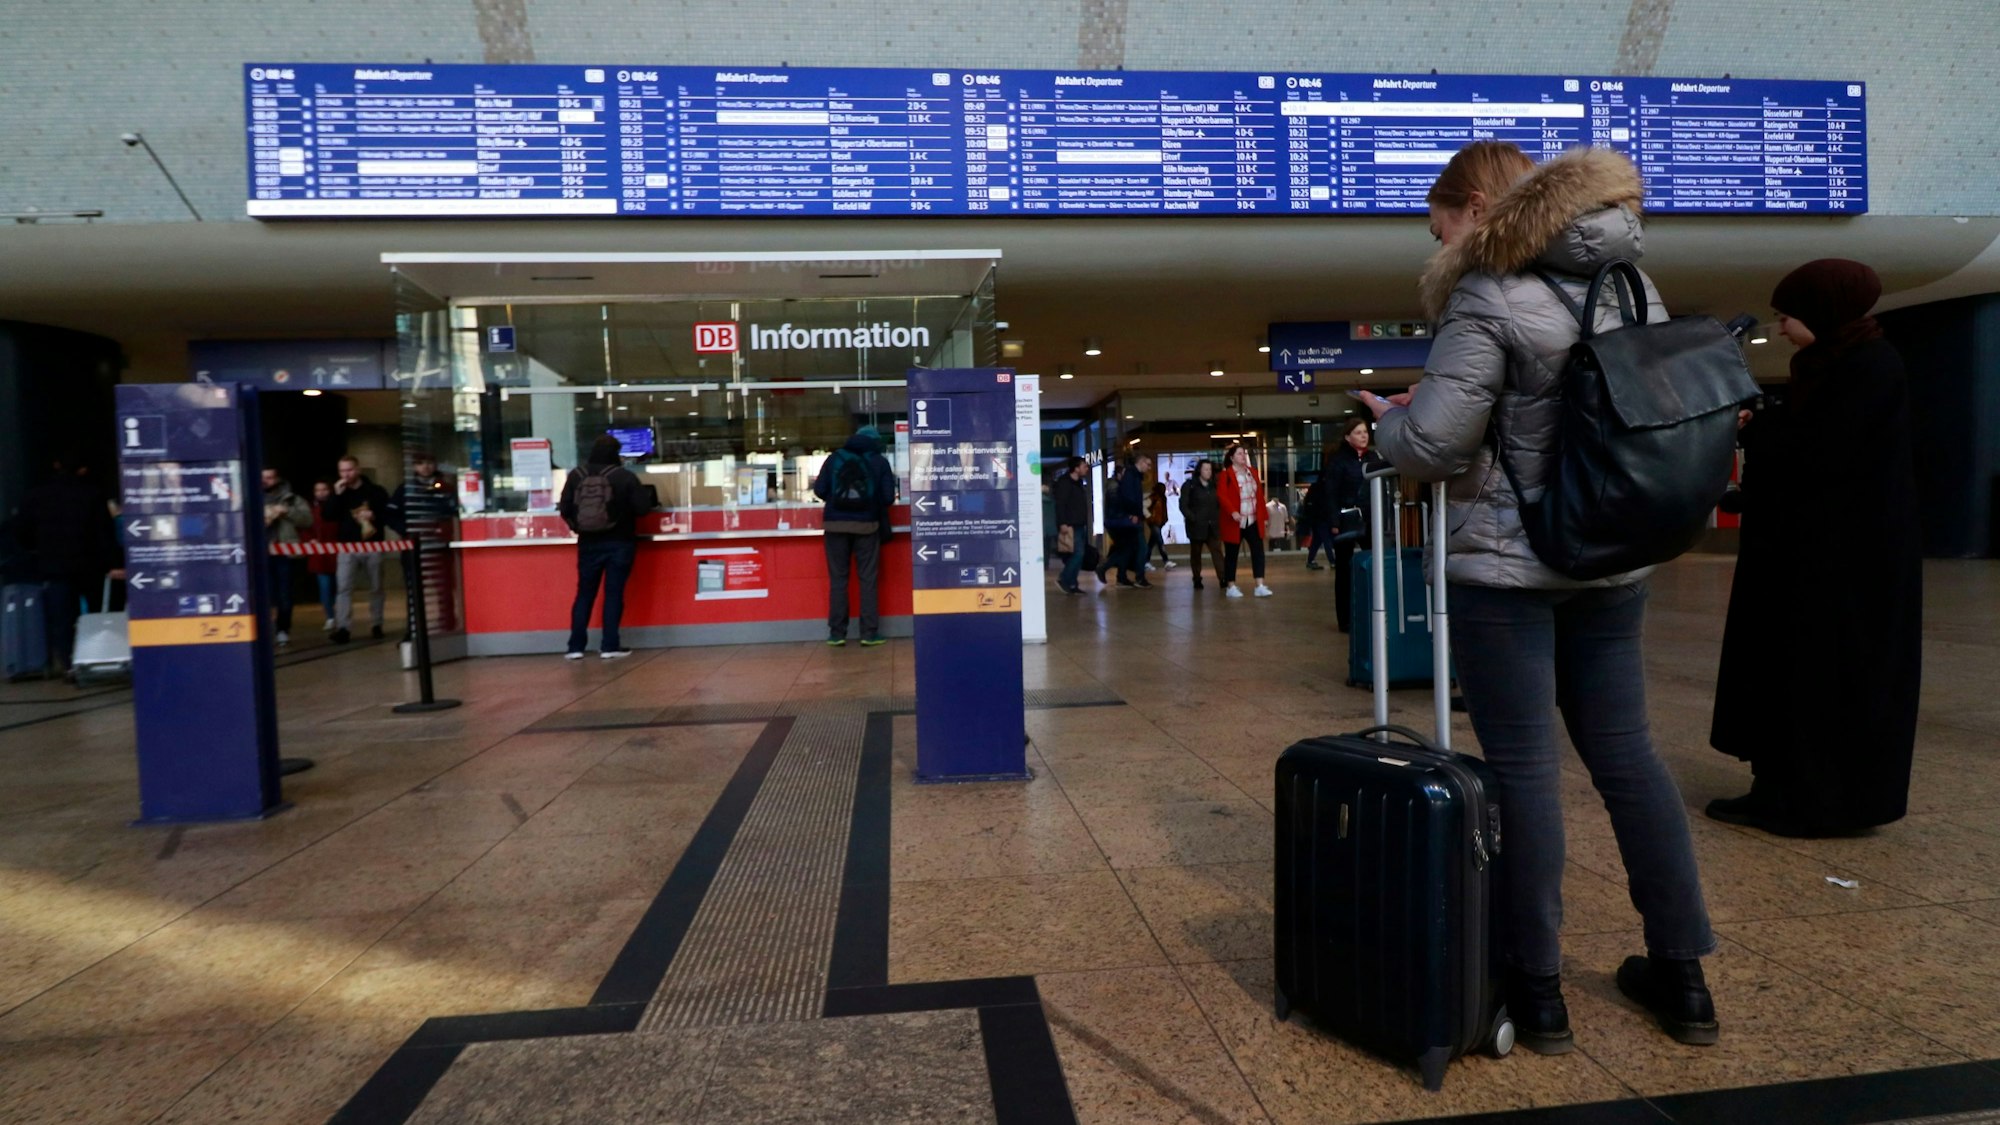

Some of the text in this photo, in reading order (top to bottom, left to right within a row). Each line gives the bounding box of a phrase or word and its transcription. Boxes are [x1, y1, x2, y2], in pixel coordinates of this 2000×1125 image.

[976, 76, 1000, 85] 08:46
[1055, 76, 1123, 87] Abfahrt Departure
[1299, 79, 1322, 88] 08:46
[1373, 79, 1437, 90] Abfahrt Departure
[1602, 82, 1623, 91] 08:46
[1671, 83, 1730, 94] Abfahrt Departure
[964, 103, 986, 111] 09:49
[1161, 104, 1219, 112] Hamm (Westf) Hbf
[1235, 104, 1252, 112] 4 A-C
[1592, 107, 1610, 115] 10:35
[1763, 109, 1803, 118] Düsseldorf Hbf
[1827, 110, 1832, 118] 5
[964, 115, 986, 123] 09:52
[1161, 116, 1234, 126] Wuppertal-Oberbarmen
[1235, 117, 1240, 125] 1
[1289, 117, 1307, 125] 10:21
[1473, 118, 1516, 126] Düsseldorf Hbf
[1542, 118, 1547, 126] 2
[1592, 119, 1610, 127] 10:37
[1764, 121, 1798, 130] Ratingen Ost
[1828, 122, 1846, 130] 10 A-B
[965, 127, 986, 135] 09:52
[1162, 128, 1195, 137] Köln/Bonn
[1235, 129, 1254, 137] 4 D-G
[1289, 129, 1307, 137] 10:21
[1473, 130, 1494, 138] Rheine
[1542, 130, 1558, 138] 2 A-C
[1593, 131, 1610, 139] 10:42
[1764, 132, 1795, 140] Krefeld Hbf
[1827, 133, 1843, 141] 9 D-G
[966, 140, 987, 148] 10:00
[1162, 140, 1182, 149] Düren
[1236, 141, 1257, 149] 11 B-C
[1289, 141, 1308, 149] 10:24
[1543, 142, 1562, 150] 10 A-B
[1764, 144, 1814, 152] Hamm (Westf) Hbf
[1828, 144, 1843, 152] 4 A-C
[909, 152, 928, 160] 1 A-C
[966, 152, 987, 160] 10:01
[1163, 153, 1181, 161] Eitorf
[1236, 153, 1258, 161] 10 A-B
[1289, 153, 1308, 161] 10:24
[1765, 155, 1827, 164] Wuppertal-Oberbarmen
[910, 164, 916, 173] 3
[967, 164, 987, 173] 10:07
[1163, 165, 1209, 174] Köln Hansaring
[1236, 165, 1258, 173] 11 B-C
[1290, 165, 1309, 173] 10:25
[1765, 167, 1793, 175] Köln/Bonn
[1828, 167, 1844, 175] 4 D-G
[910, 177, 934, 185] 10 A-B
[967, 177, 988, 185] 10:07
[1163, 177, 1212, 186] Minden (Westf)
[1236, 177, 1255, 185] 9 D-G
[1290, 177, 1309, 185] 10:25
[1765, 178, 1782, 186] Düren
[1829, 178, 1847, 186] 11 B-C
[910, 189, 917, 198] 4
[968, 189, 988, 198] 10:11
[1164, 189, 1215, 198] Hamburg-Altona
[1237, 189, 1242, 197] 4
[1290, 189, 1309, 197] 10:25
[1765, 189, 1791, 198] Au (Sieg)
[911, 202, 931, 210] 9 D-G
[968, 202, 989, 210] 10:15
[1164, 201, 1200, 210] Aachen Hbf
[1237, 201, 1256, 209] 9 D-G
[1291, 201, 1309, 209] 10:31
[1766, 201, 1807, 209] Minden (Westf)
[1372, 325, 1383, 337] S
[697, 321, 930, 351] DB Information
[1307, 347, 1320, 355] den
[1321, 347, 1342, 357] Zügen
[1298, 357, 1335, 365] koelnmesse
[947, 446, 1013, 455] Fahrkartenverkauf
